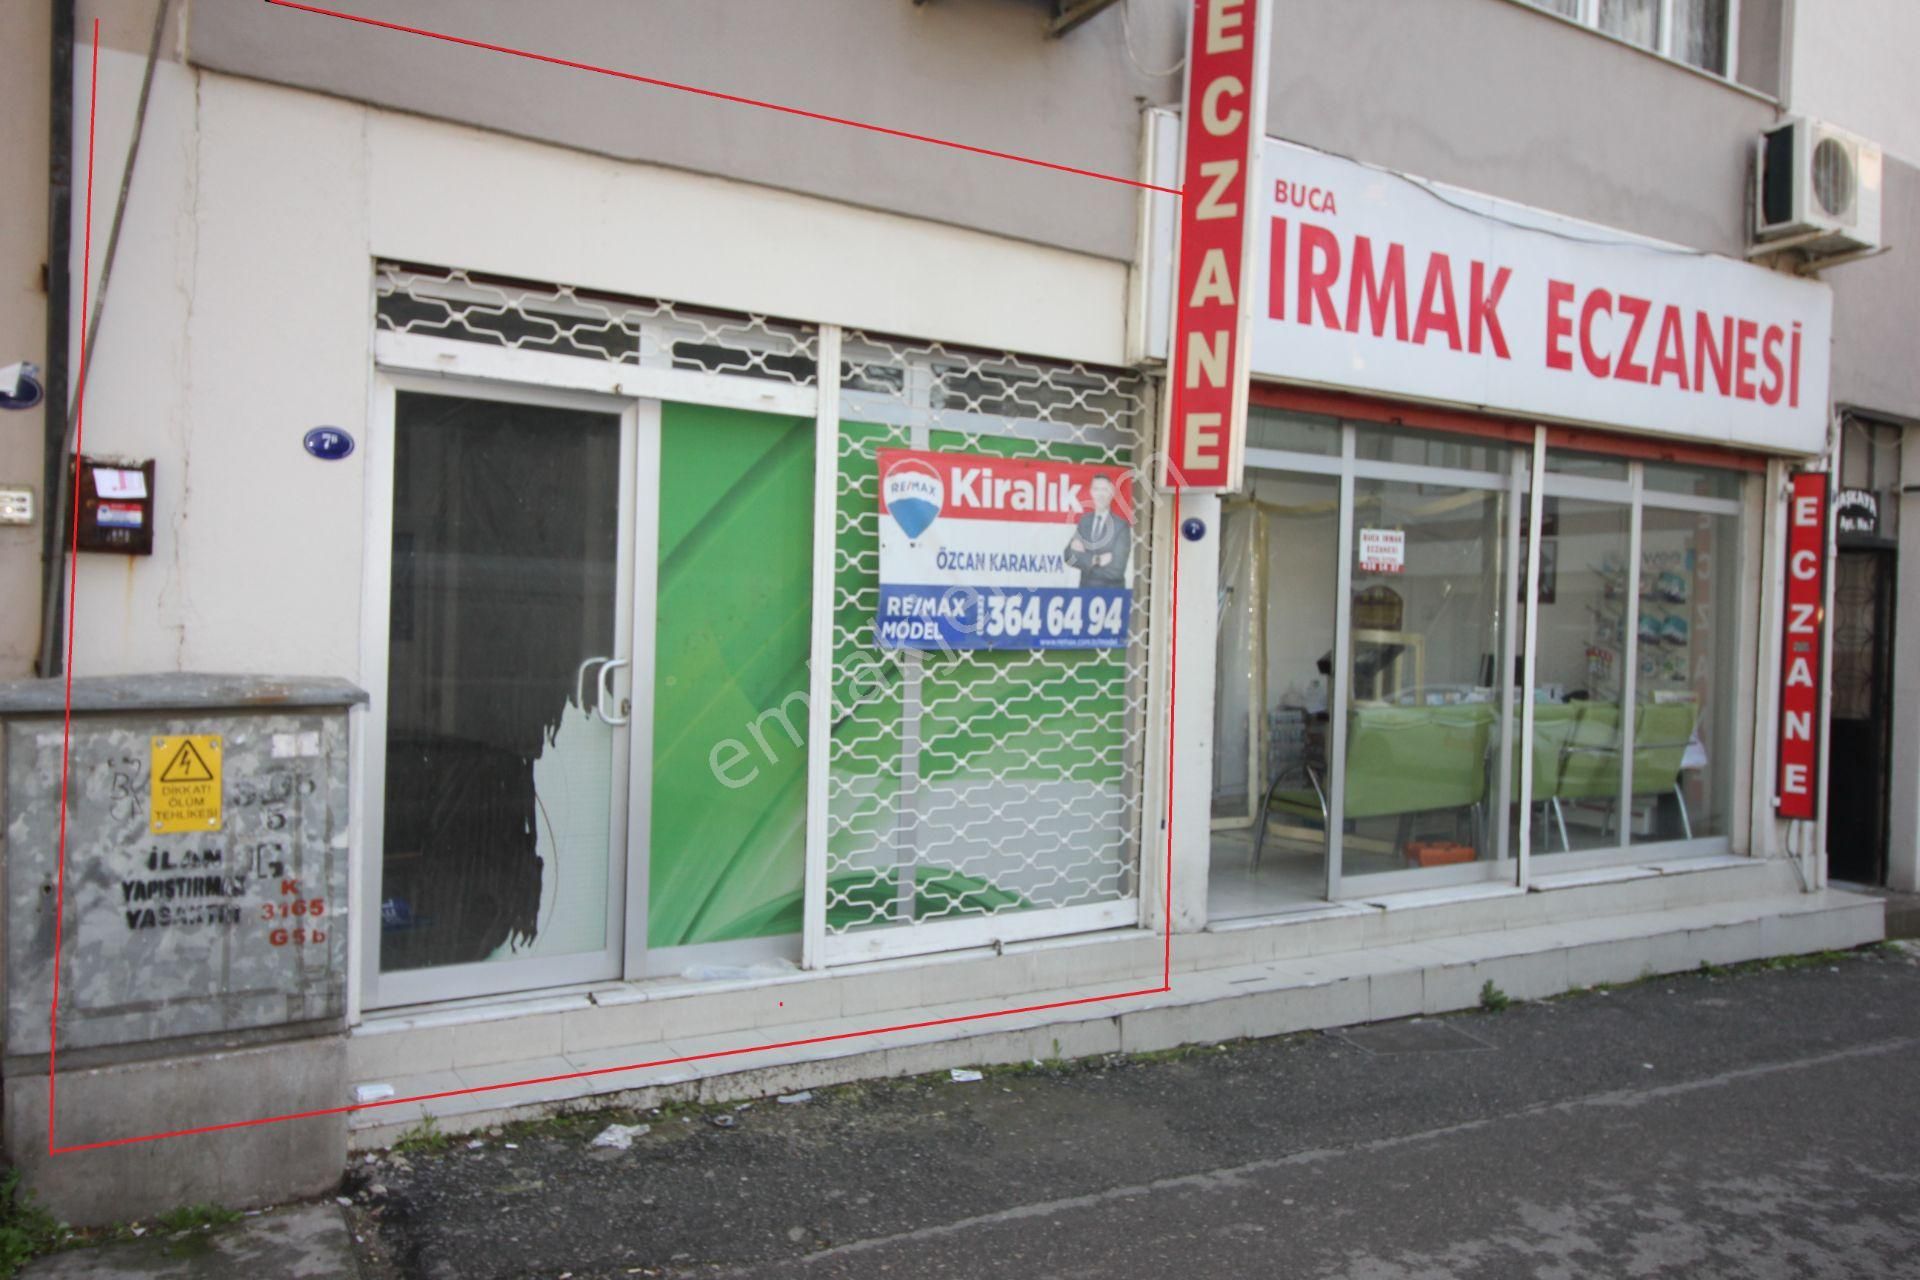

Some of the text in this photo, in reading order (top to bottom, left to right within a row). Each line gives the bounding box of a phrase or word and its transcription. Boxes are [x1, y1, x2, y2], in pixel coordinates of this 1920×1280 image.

[1275, 179, 1337, 216] BUCA
[1183, 0, 1245, 470] ECZANE
[1268, 216, 1803, 410] IRMAK ECZANESİ
[890, 480, 937, 497] RE/MAX
[951, 467, 1084, 514] Kiralık
[936, 547, 1065, 574] ÖZCAN KARAKAYA
[881, 620, 943, 641] MODEL
[886, 595, 966, 618] RE/MAX
[987, 594, 1041, 637] 364
[1047, 595, 1083, 637] 64
[1088, 595, 1124, 636] 94
[1784, 496, 1818, 794] ECZANE
[280, 879, 299, 896] K
[262, 897, 325, 920] 3165
